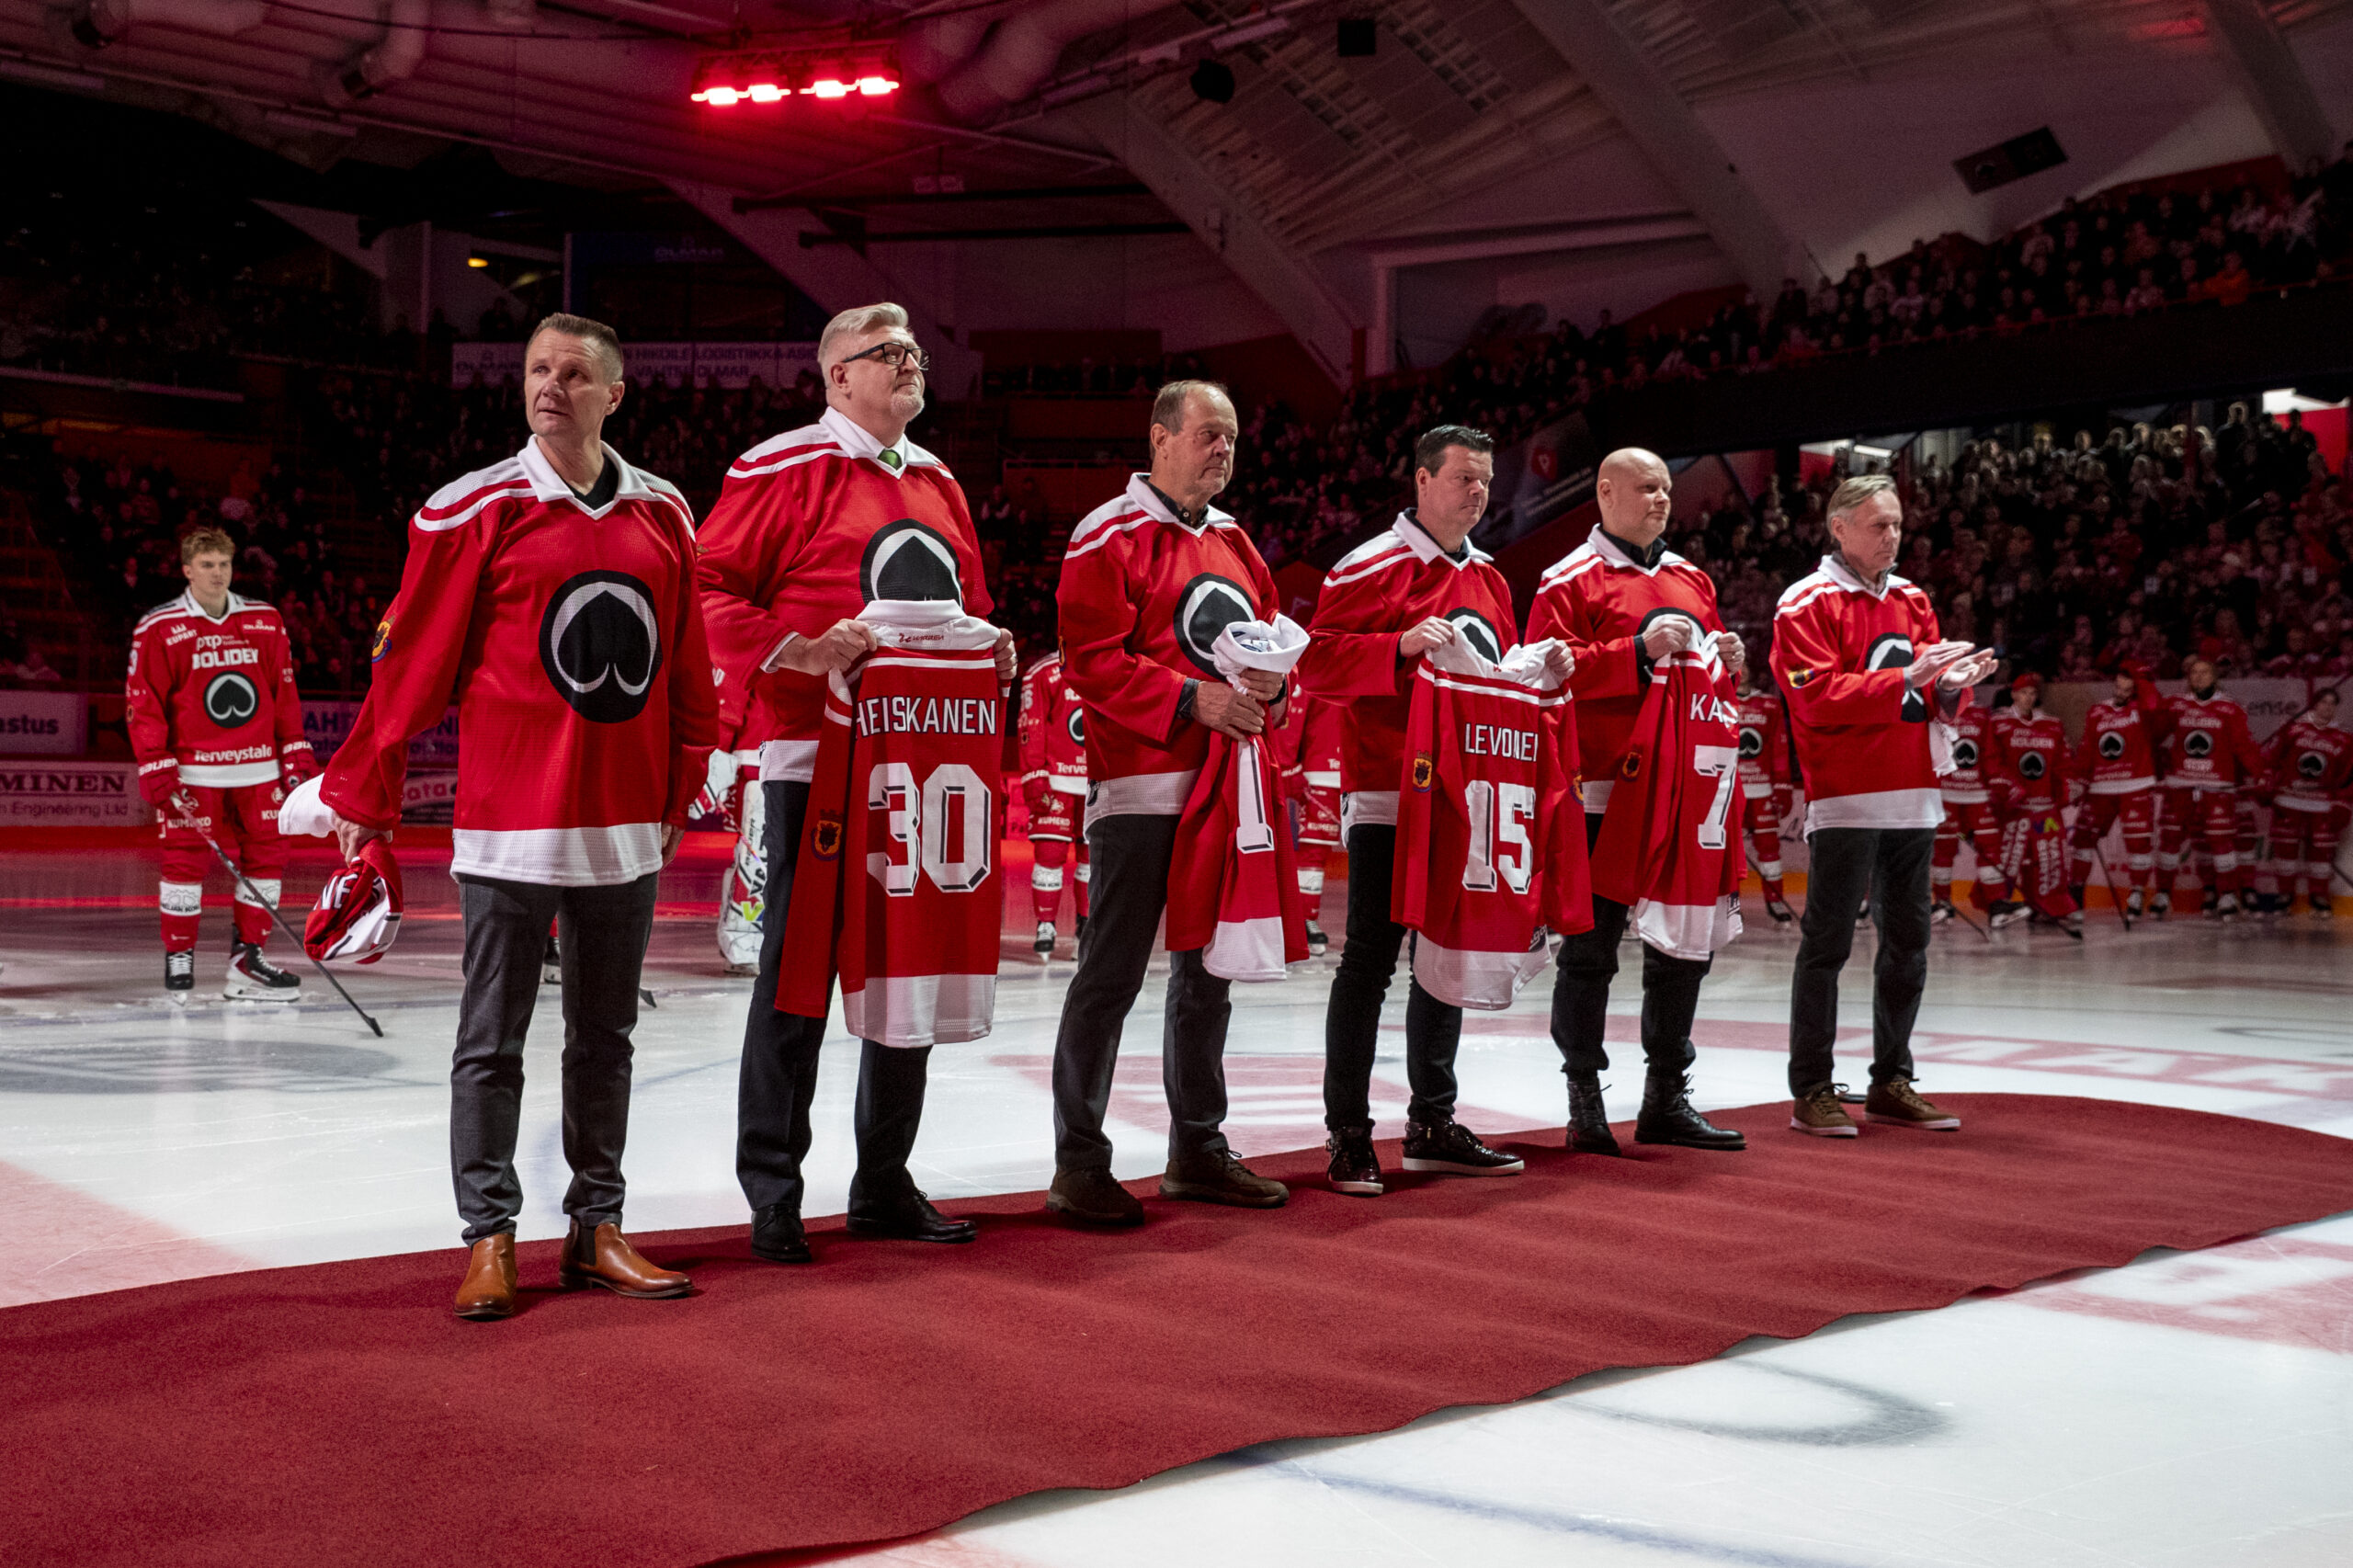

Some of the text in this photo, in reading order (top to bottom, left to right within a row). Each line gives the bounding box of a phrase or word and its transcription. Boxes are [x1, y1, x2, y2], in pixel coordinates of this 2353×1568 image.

[856, 696, 996, 739] HEISKANEN
[866, 761, 993, 899] 30
[1461, 779, 1536, 895] 15
[1693, 744, 1740, 850] 7
